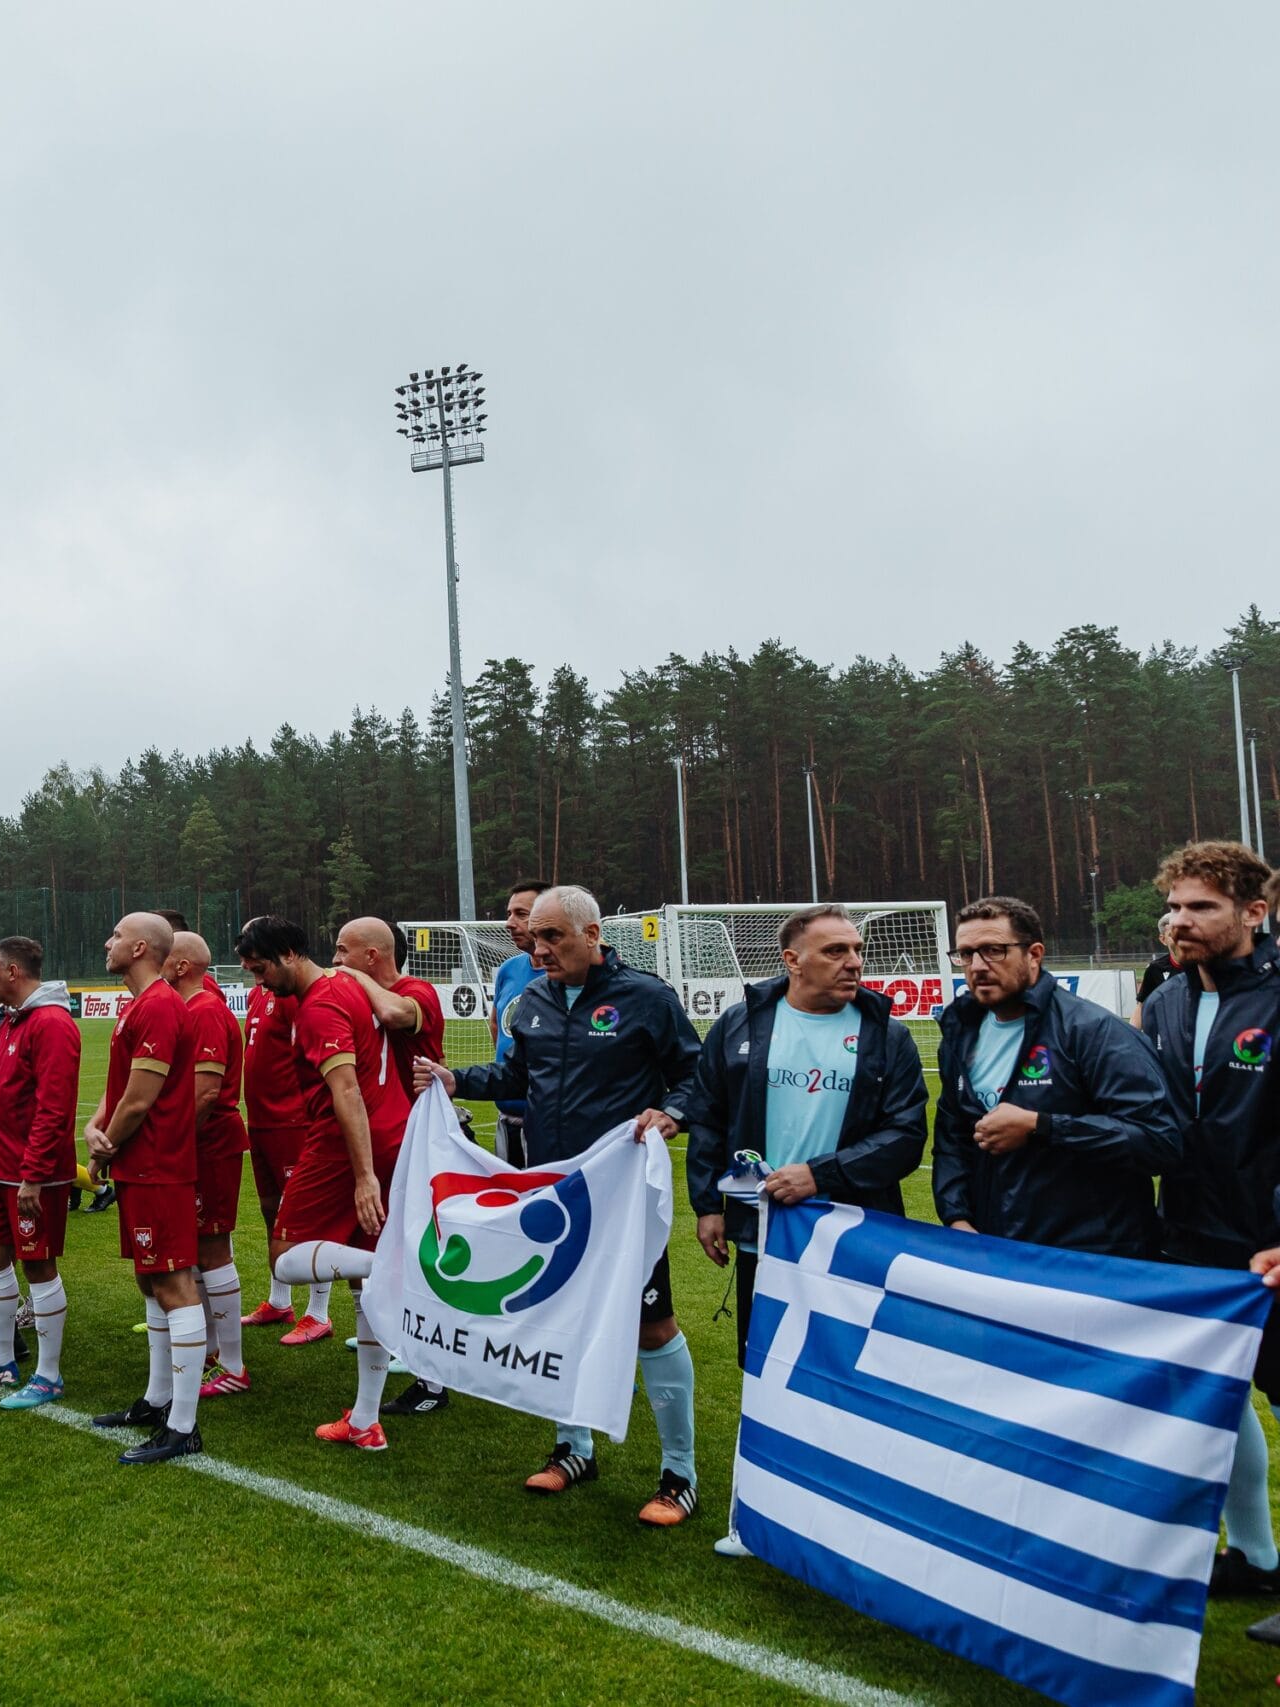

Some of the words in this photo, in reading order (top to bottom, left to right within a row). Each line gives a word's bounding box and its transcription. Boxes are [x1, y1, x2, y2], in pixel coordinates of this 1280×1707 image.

[646, 921, 656, 937] 2
[225, 989, 249, 1011] aut
[682, 982, 726, 1016] ler
[767, 1068, 851, 1093] URO2da
